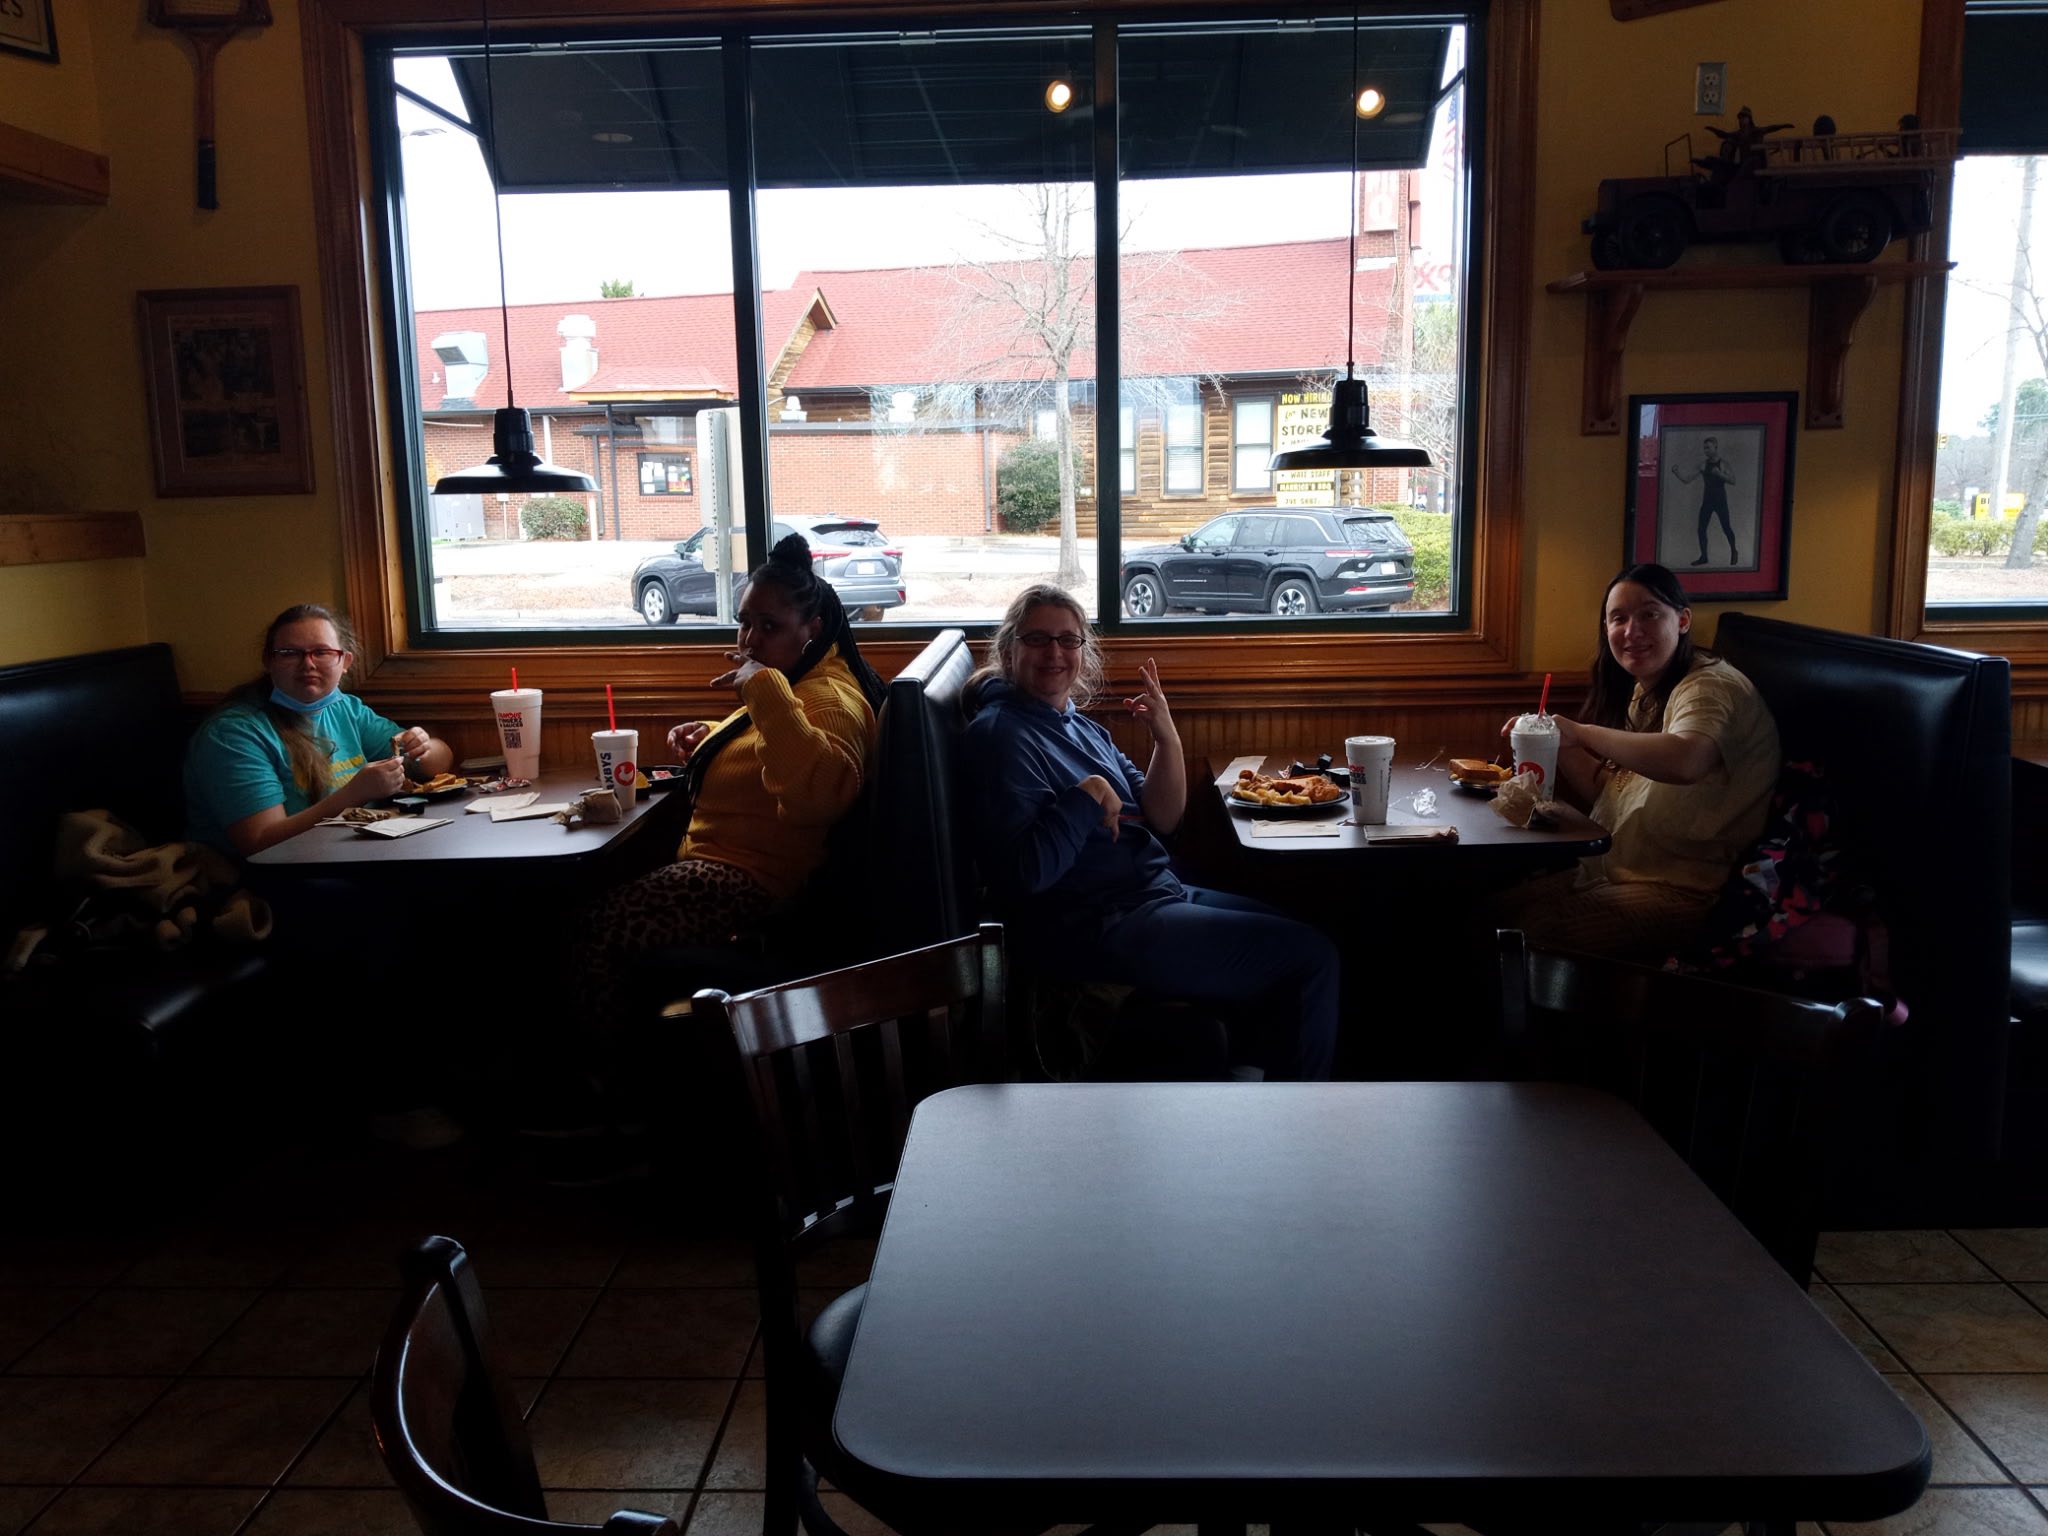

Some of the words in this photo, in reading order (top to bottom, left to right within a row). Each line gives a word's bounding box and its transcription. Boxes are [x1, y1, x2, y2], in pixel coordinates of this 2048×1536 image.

[1281, 393, 1301, 404] NOW
[1301, 408, 1328, 419] NEW
[1291, 471, 1306, 479] WAIT
[1311, 470, 1331, 478] STAFF
[600, 752, 616, 797] AXBYS
